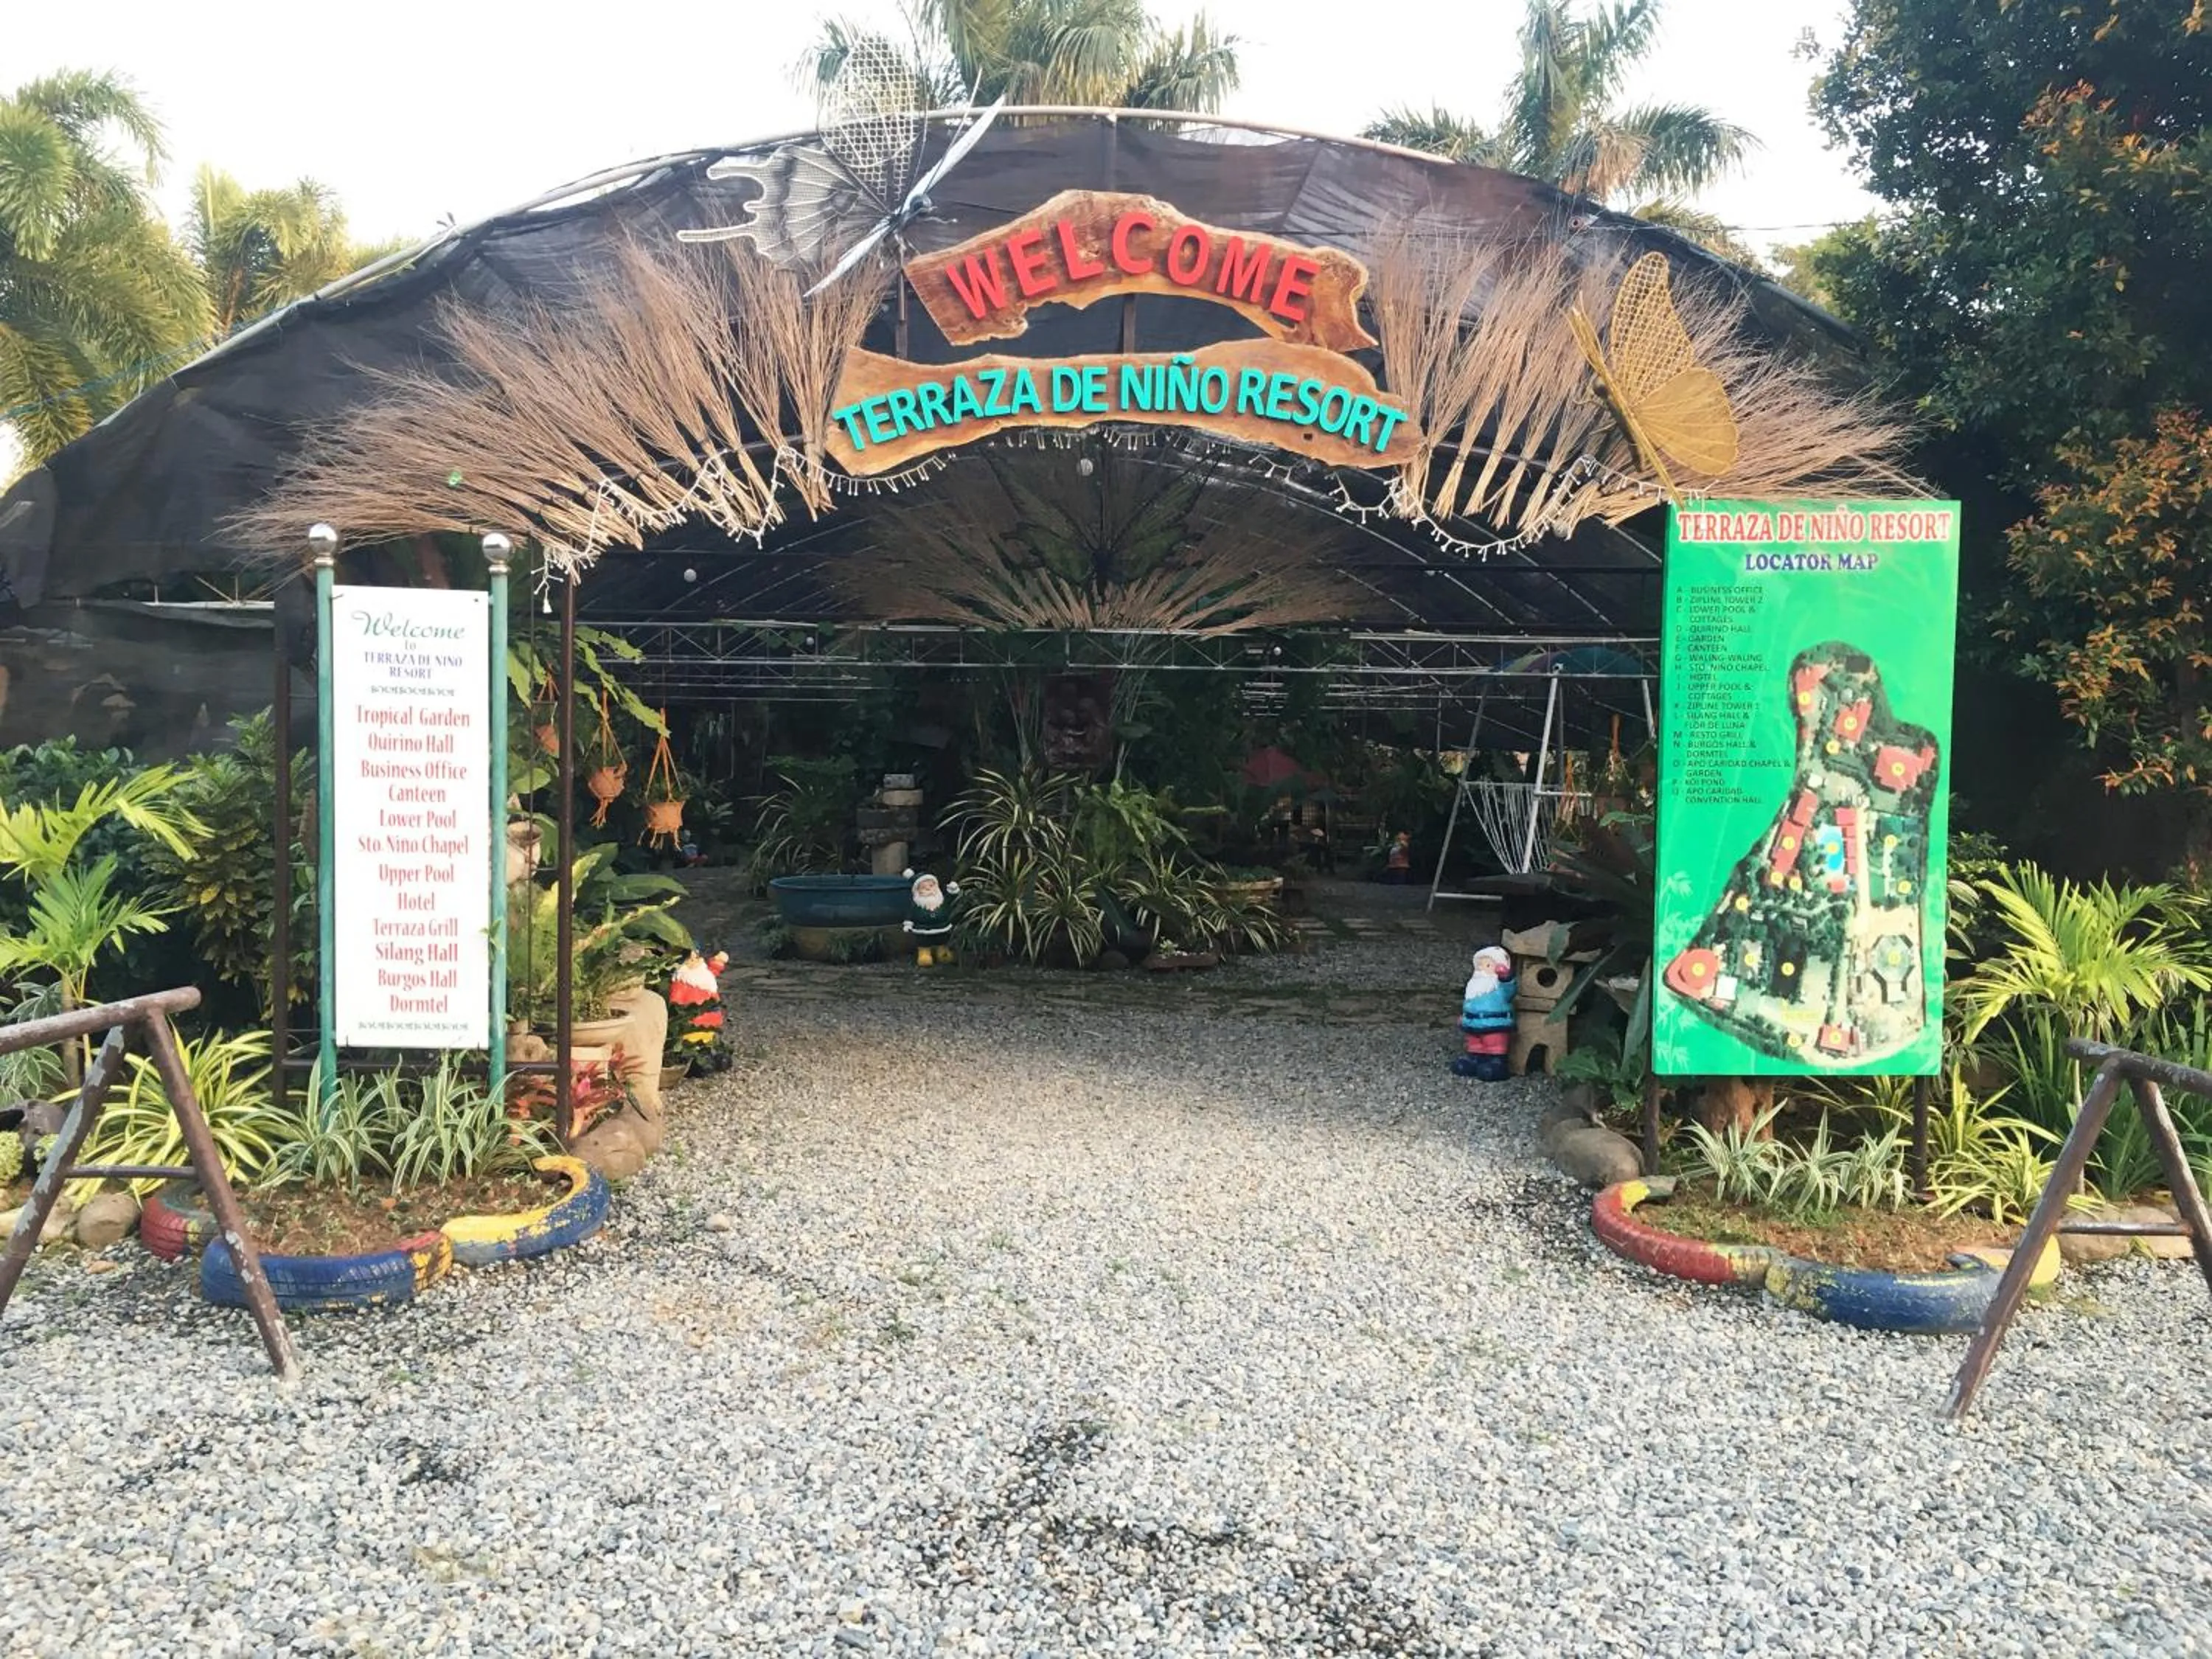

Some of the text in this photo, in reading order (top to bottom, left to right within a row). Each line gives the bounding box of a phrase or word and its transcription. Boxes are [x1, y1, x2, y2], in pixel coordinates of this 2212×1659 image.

[945, 212, 1322, 323] WELCOME
[832, 354, 1407, 453] TERRAZA DE NIÑO RESORT
[1678, 505, 1950, 542] TERRAZA DE NIÑO RESORT
[1745, 553, 1878, 571] LOCATOR MAP
[352, 611, 465, 639] Welcome
[405, 640, 416, 651] to
[364, 652, 415, 666] TERRAZA
[389, 667, 432, 679] RESORT
[356, 705, 470, 728] Tropical Garden
[367, 733, 453, 753] Quirino Hall
[361, 760, 467, 779] Business Office
[389, 785, 446, 803] Canteen
[379, 809, 456, 828] Lower Pool
[422, 836, 469, 858] Chapel
[378, 863, 454, 886] Upper Pool
[397, 892, 435, 911] Hotel
[372, 918, 458, 936] Terraza Grill
[376, 942, 458, 964] Silang Hall
[378, 969, 457, 991] Burgos Hall
[390, 995, 448, 1013] Dormtel
